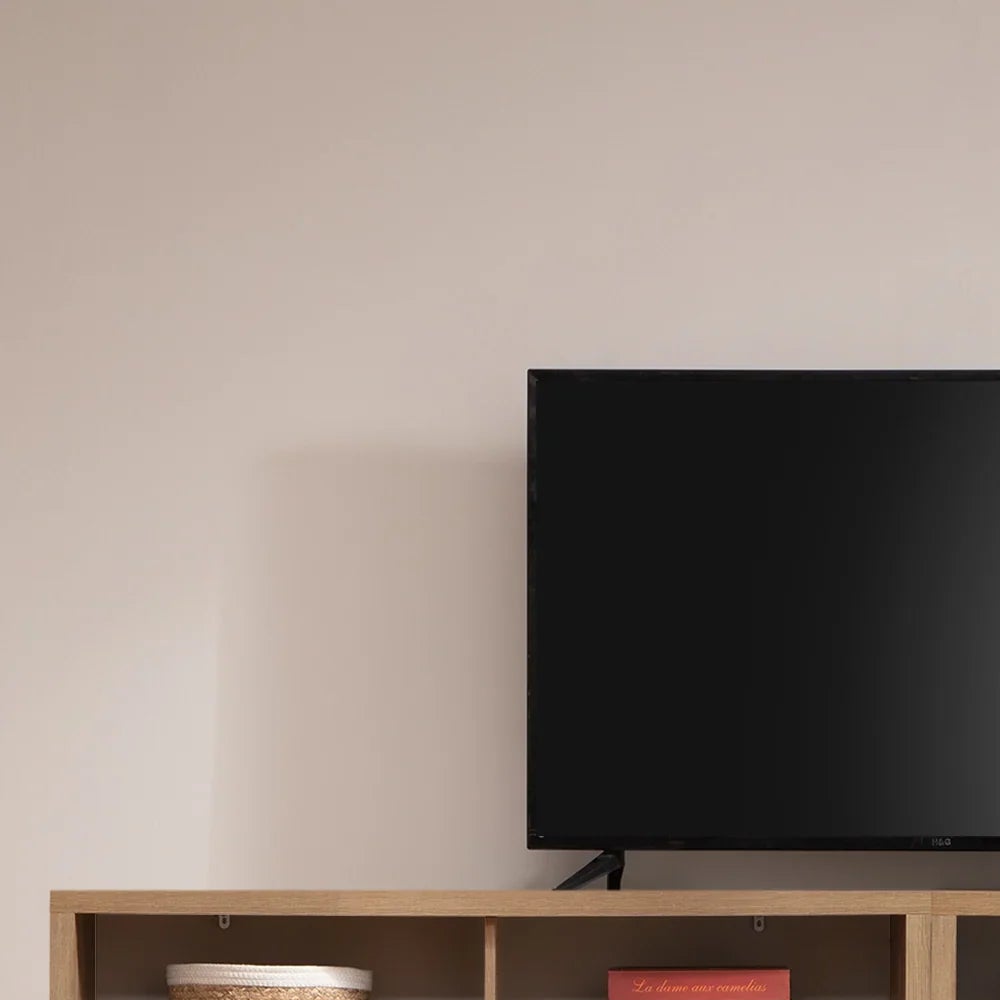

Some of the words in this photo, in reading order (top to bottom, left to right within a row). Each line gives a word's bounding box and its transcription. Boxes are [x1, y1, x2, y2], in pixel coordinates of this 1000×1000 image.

[632, 977, 652, 993] La
[656, 979, 688, 993] dame
[691, 984, 714, 993] aux
